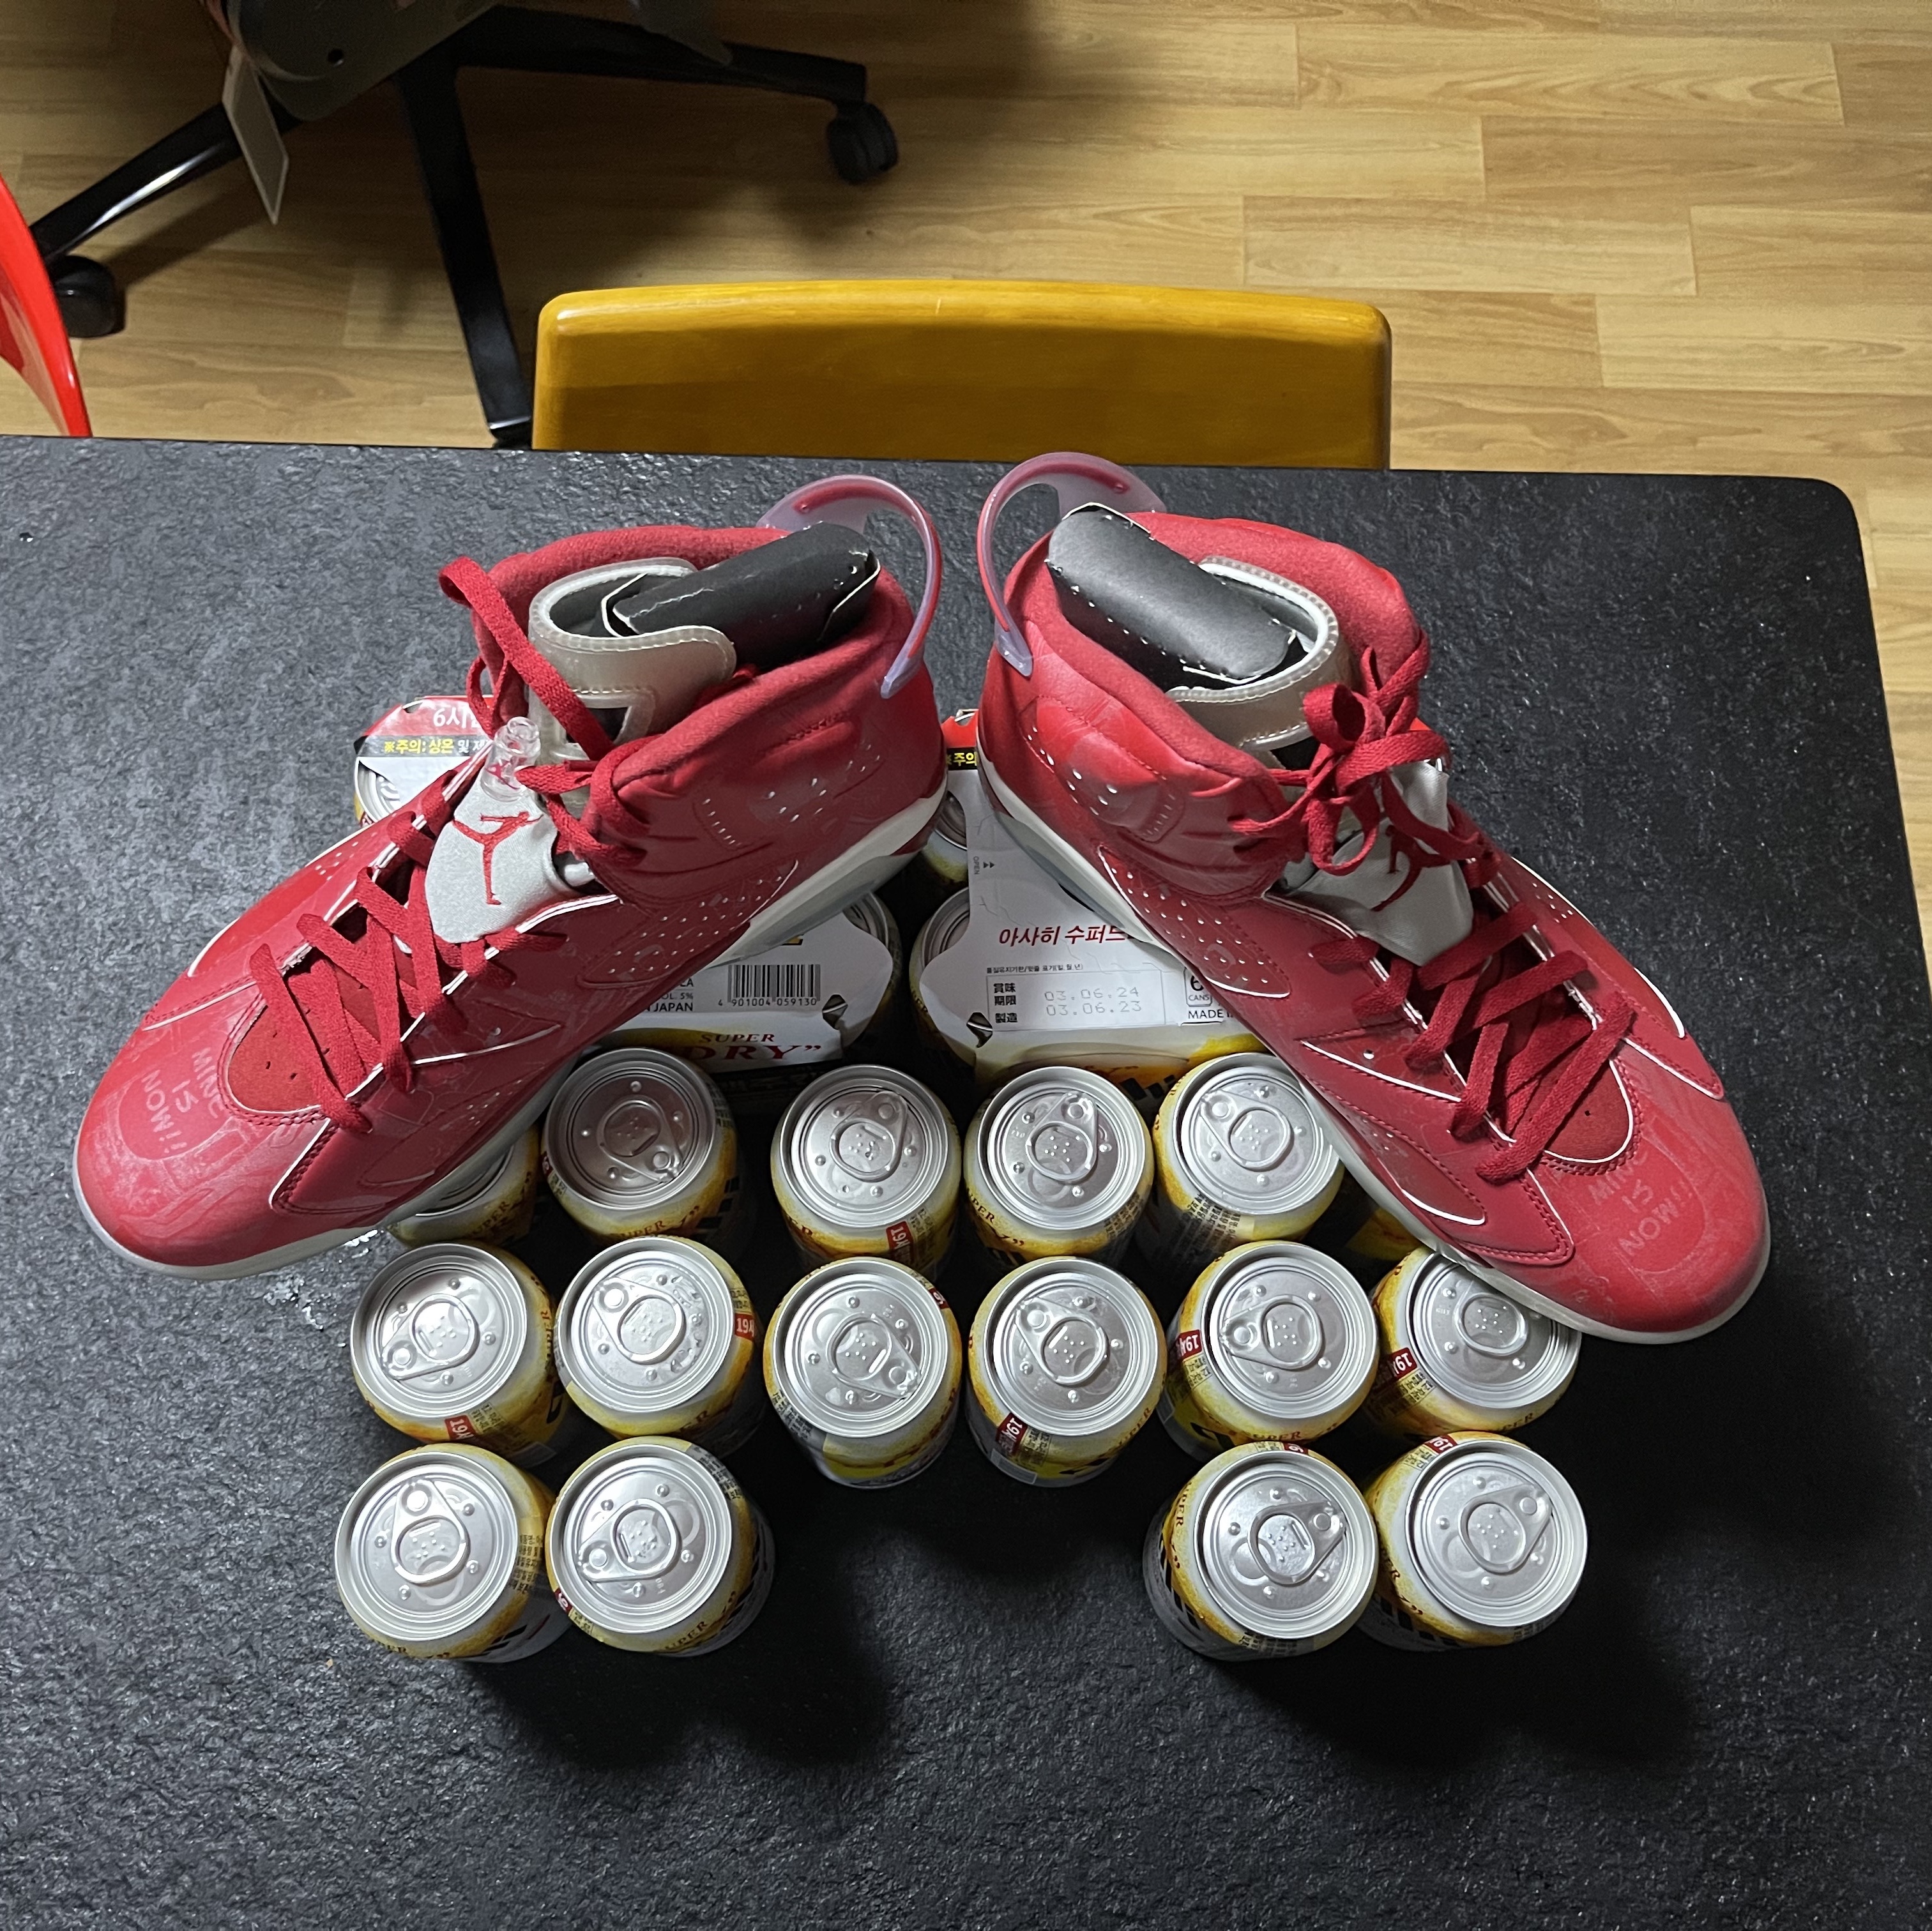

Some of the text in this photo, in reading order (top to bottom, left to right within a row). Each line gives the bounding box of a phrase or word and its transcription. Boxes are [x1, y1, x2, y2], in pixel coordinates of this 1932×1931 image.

[429, 738, 454, 754] 상온
[457, 739, 469, 753] 및
[998, 926, 1061, 947] 아사히
[993, 982, 1016, 994] 賞味
[1044, 987, 1139, 1001] 03.06.24
[777, 998, 817, 1006] 059130
[994, 995, 1016, 1006] 期限
[653, 1002, 694, 1012] JAPAN
[1046, 1001, 1142, 1016] 03.06.23
[995, 1012, 1018, 1023] 製造
[1188, 1009, 1224, 1020] MADE
[700, 1033, 775, 1043] SUPER
[172, 1079, 199, 1113] IS
